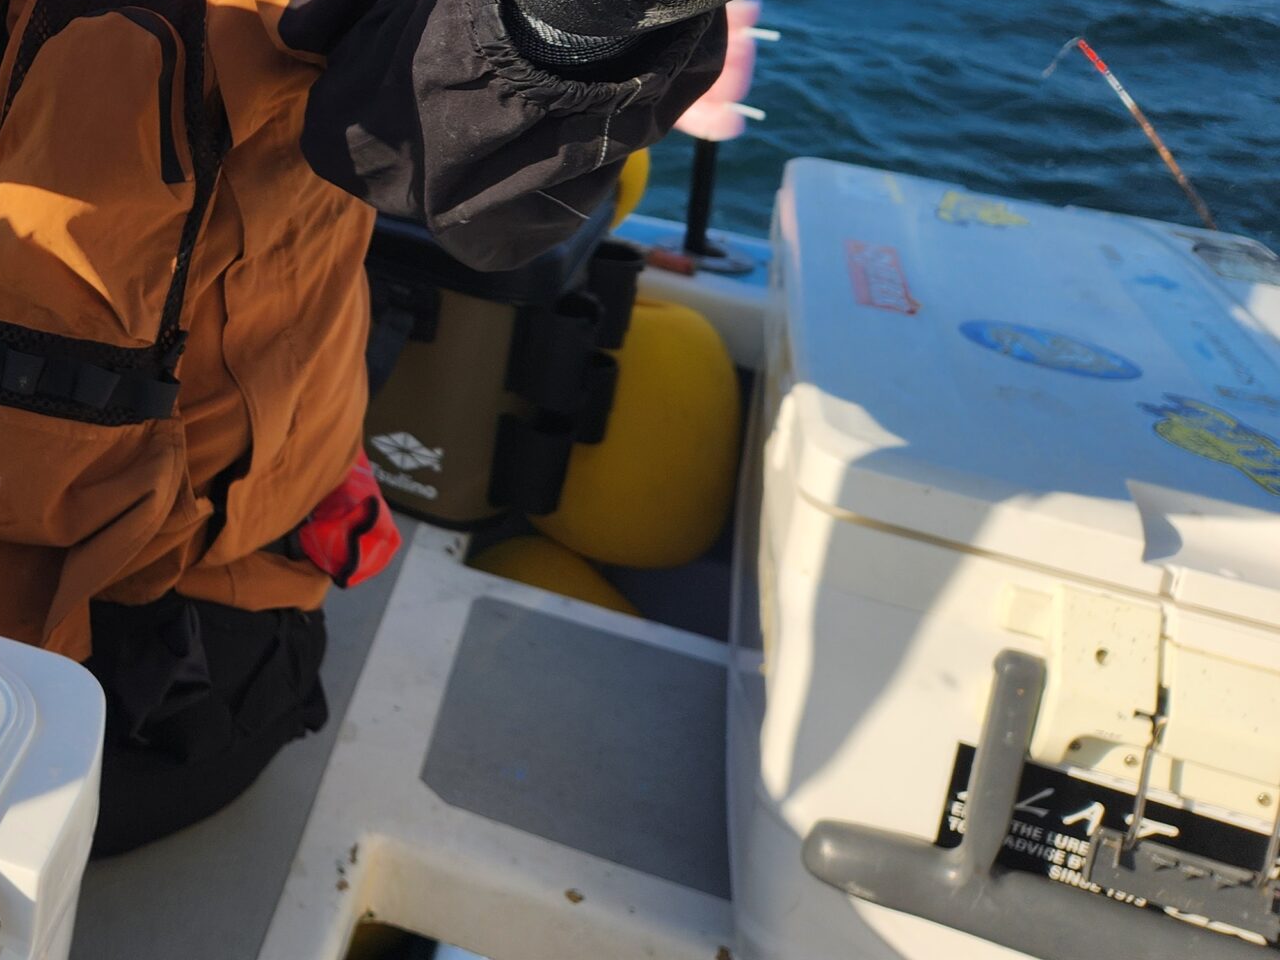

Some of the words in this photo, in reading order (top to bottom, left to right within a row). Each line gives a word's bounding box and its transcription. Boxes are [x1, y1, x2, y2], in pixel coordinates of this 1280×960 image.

[1004, 835, 1066, 865] ADVICE
[1011, 820, 1044, 841] THE
[1047, 830, 1090, 856] LURE
